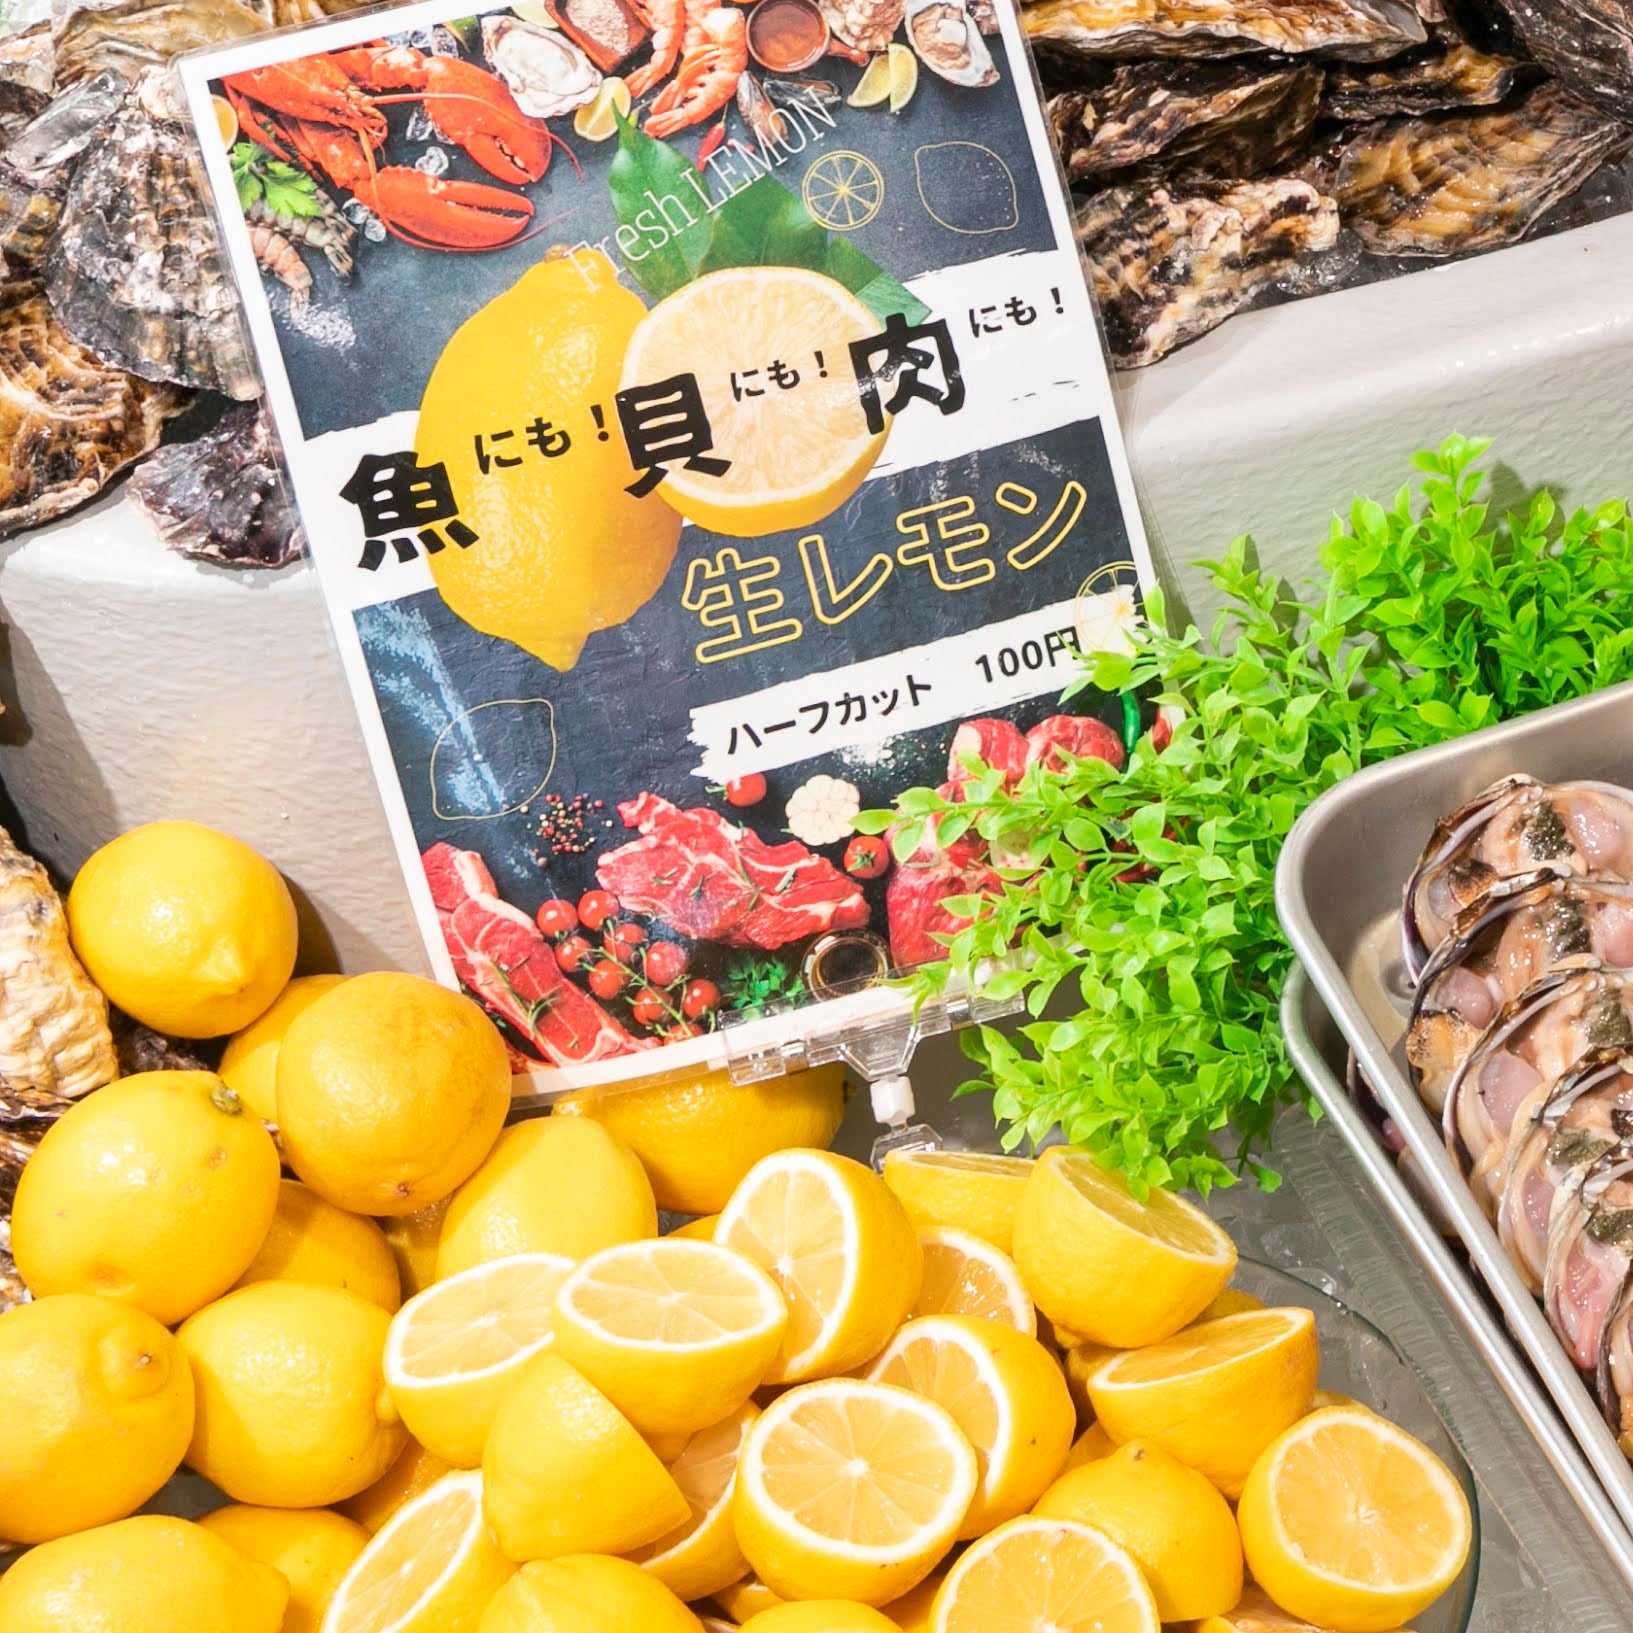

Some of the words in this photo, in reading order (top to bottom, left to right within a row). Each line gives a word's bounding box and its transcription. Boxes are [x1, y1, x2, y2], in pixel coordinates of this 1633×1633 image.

[562, 188, 698, 293] Fresh
[680, 84, 838, 215] LEMON
[681, 479, 1088, 665] 生レモン
[727, 674, 932, 755] ハーフカット
[974, 625, 1083, 684] 100円
